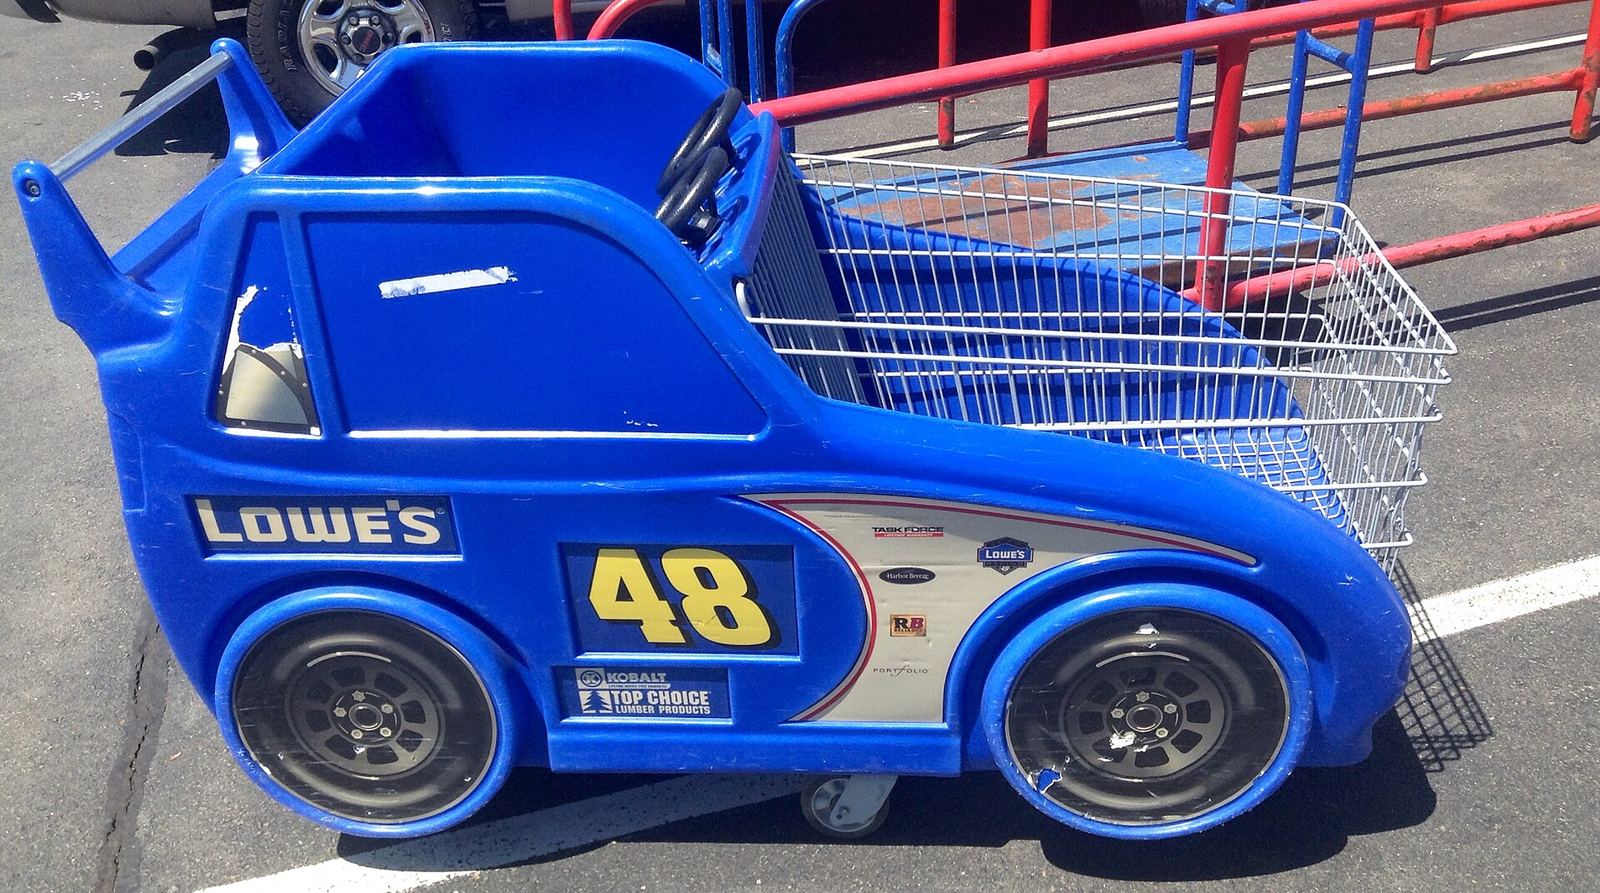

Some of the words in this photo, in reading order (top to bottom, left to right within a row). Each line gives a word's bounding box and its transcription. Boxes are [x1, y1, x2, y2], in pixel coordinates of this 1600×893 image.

[195, 499, 441, 545] LOWE'S
[985, 549, 1025, 559] LOWE'S
[588, 547, 775, 646] 48
[894, 617, 924, 629] RB
[606, 672, 667, 683] KOBALT
[611, 690, 644, 705] TOP
[647, 690, 710, 706] CHOICE
[615, 704, 655, 714] LUMBER
[659, 705, 711, 715] PRODUCTS
